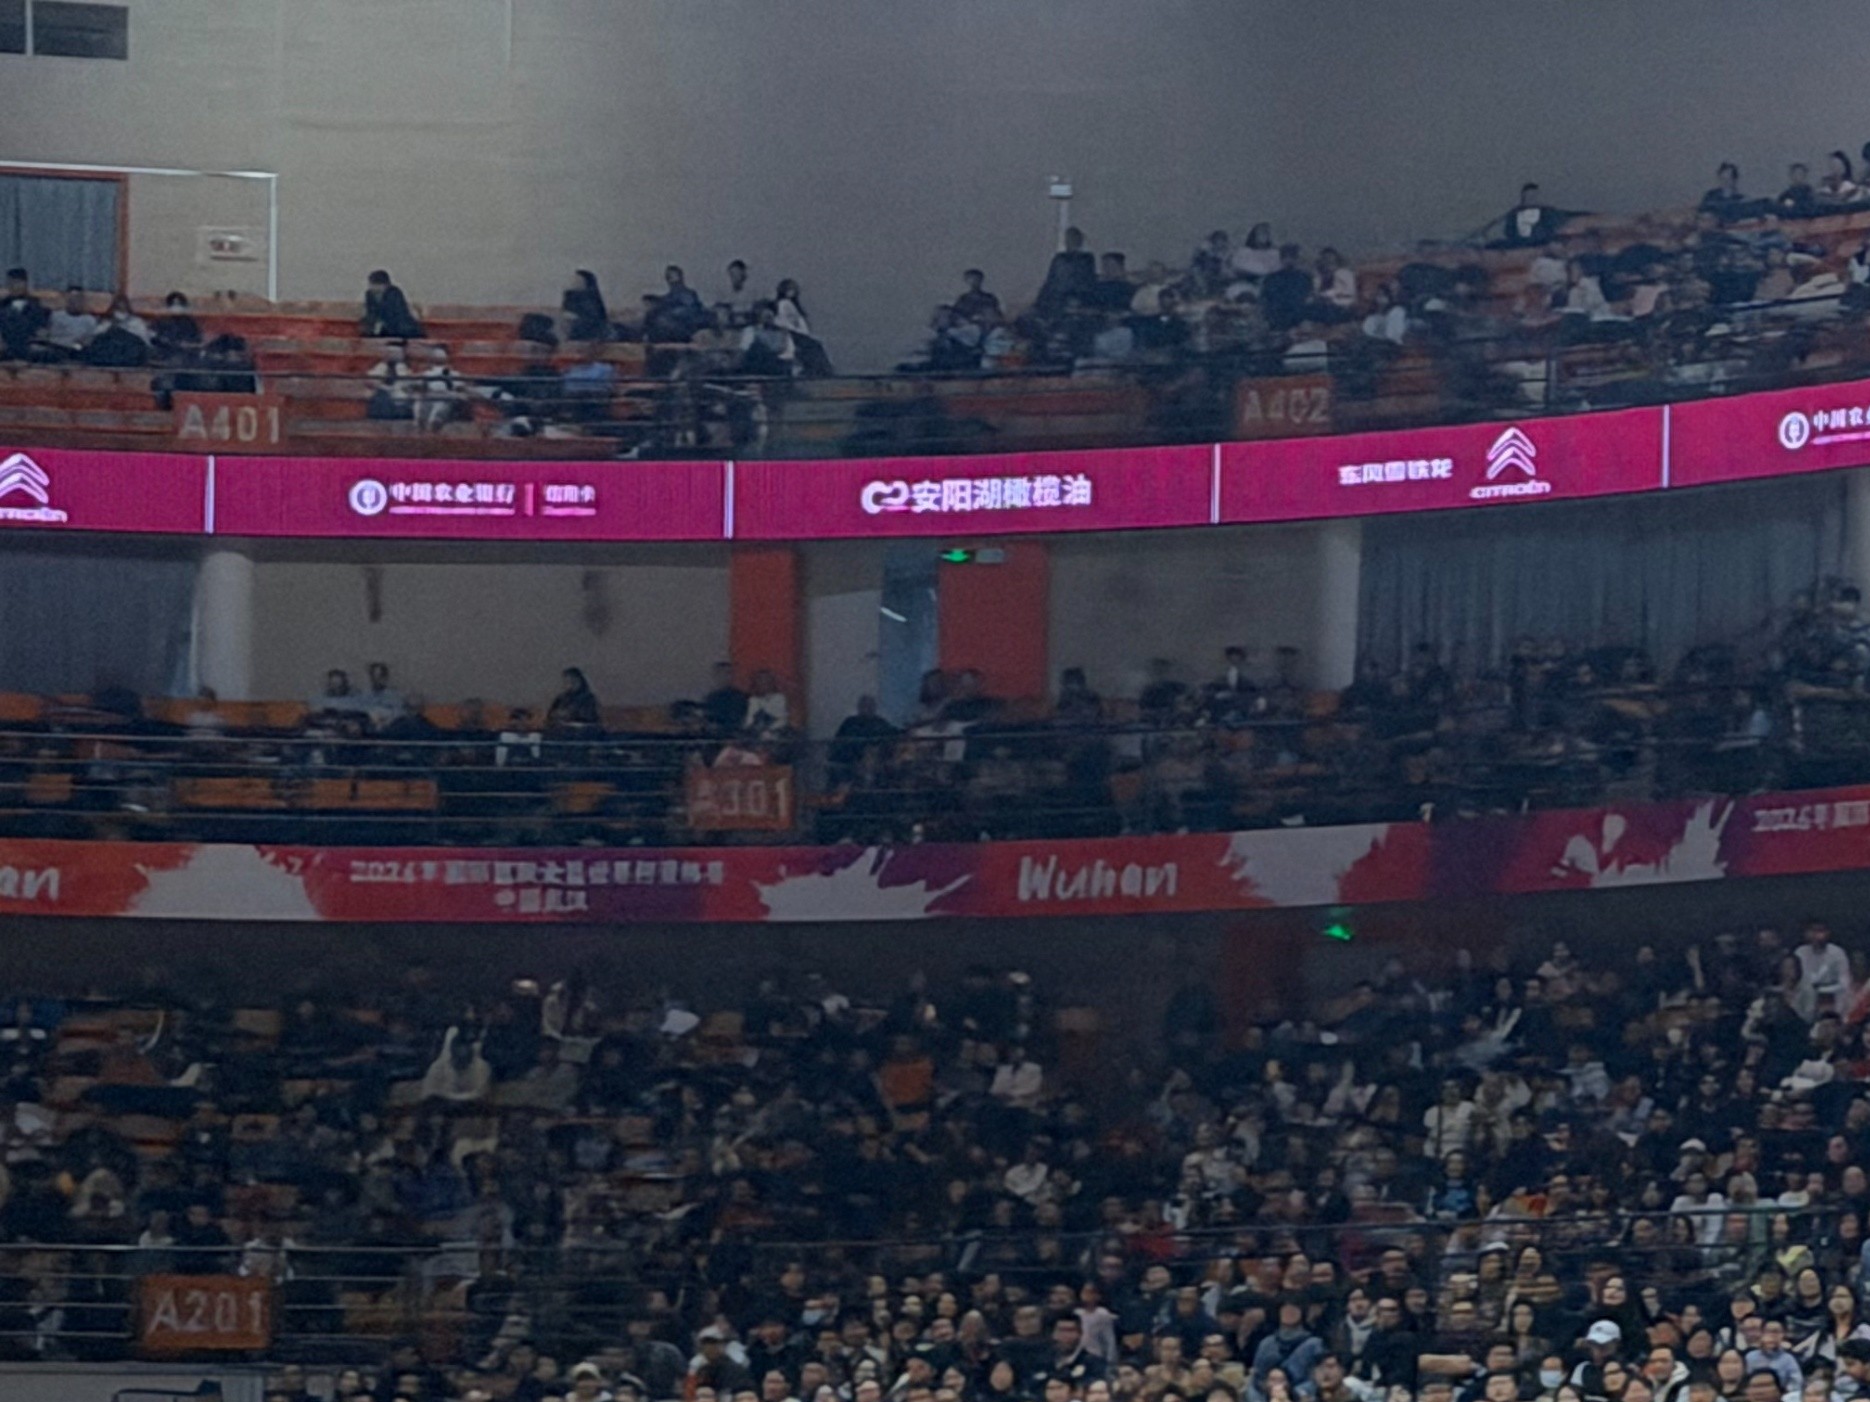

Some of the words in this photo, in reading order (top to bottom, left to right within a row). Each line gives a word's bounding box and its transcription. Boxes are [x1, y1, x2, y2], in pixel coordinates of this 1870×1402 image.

[179, 404, 280, 441] A401
[911, 473, 1092, 513] 安阳湖橄榄油
[1017, 853, 1178, 901] Wuhan
[150, 1290, 264, 1334] A201
